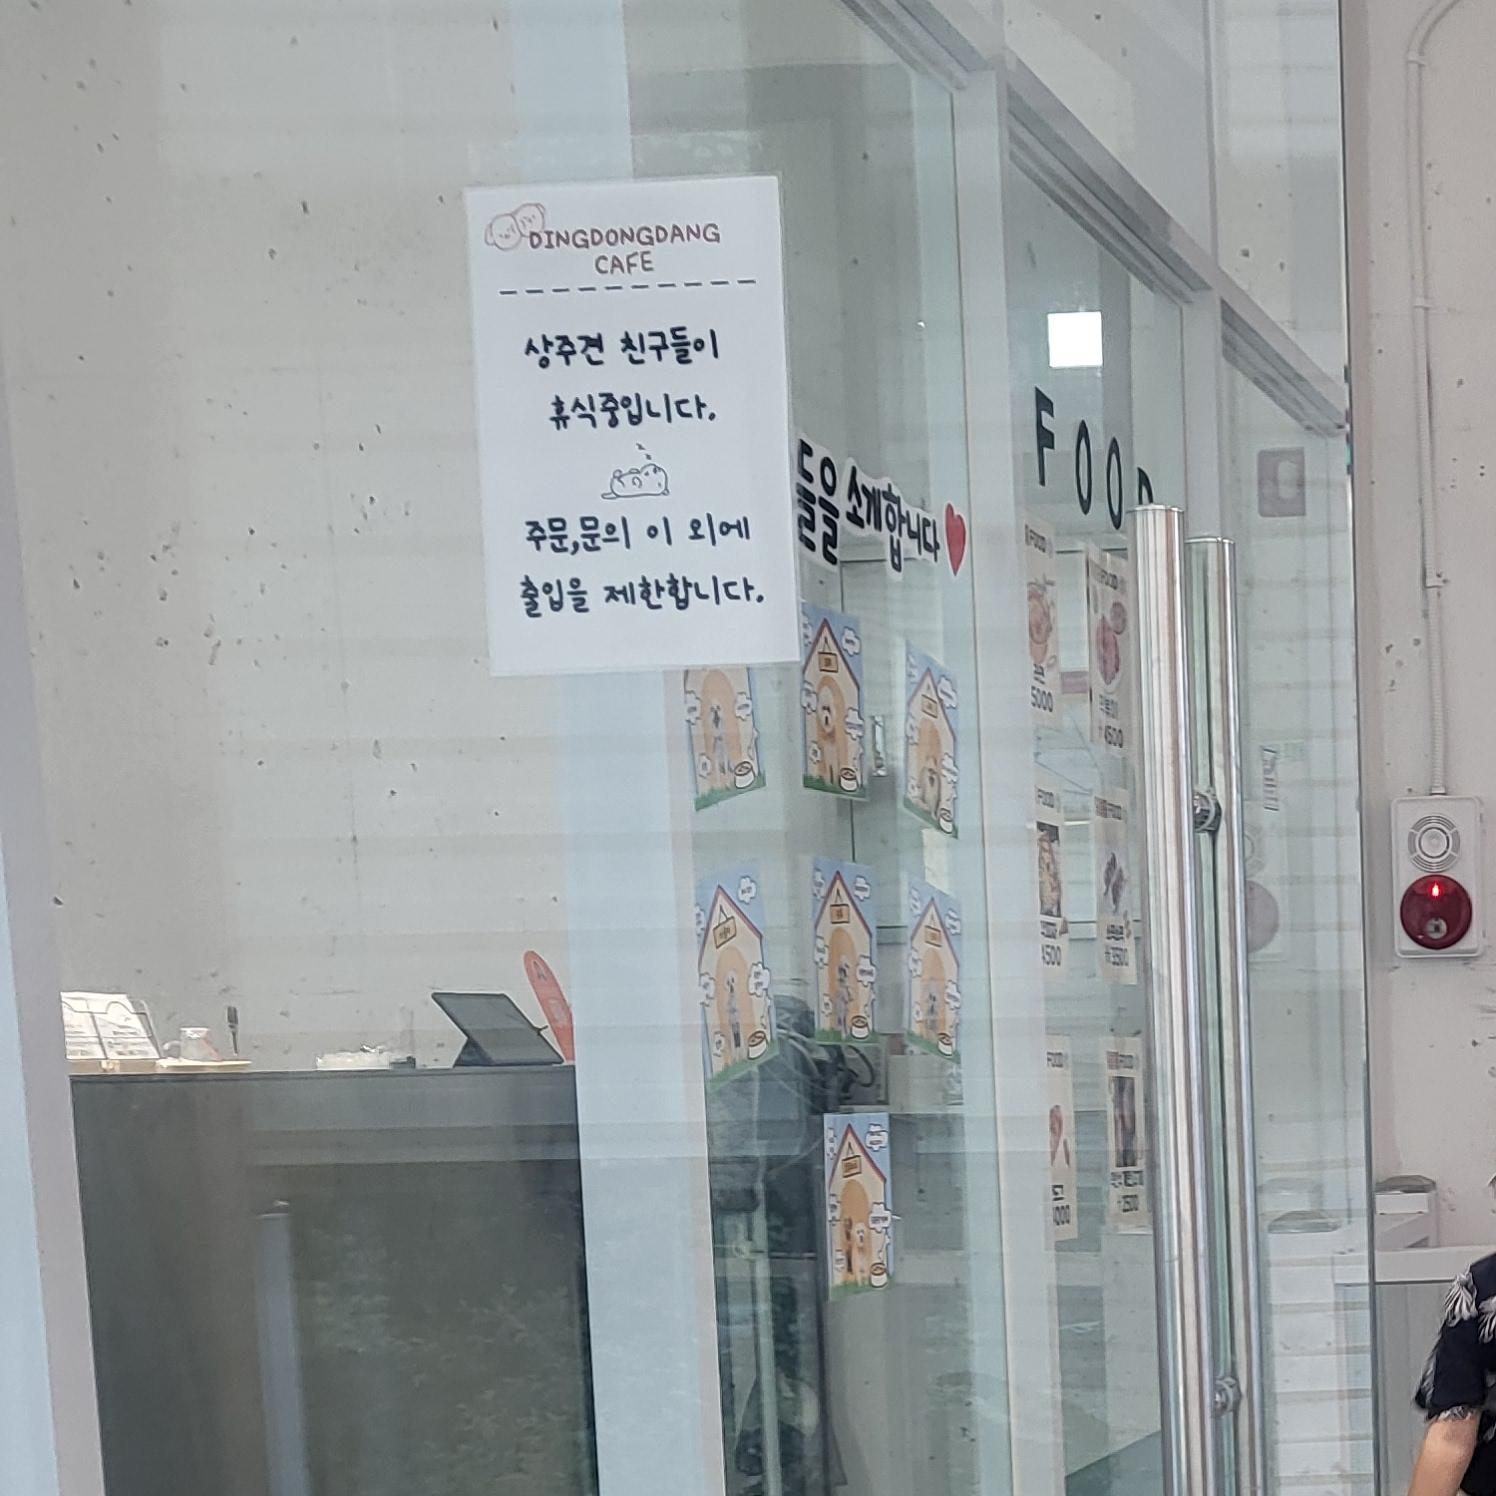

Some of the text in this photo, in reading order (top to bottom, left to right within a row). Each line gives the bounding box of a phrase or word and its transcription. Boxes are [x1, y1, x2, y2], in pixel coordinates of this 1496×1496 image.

[528, 222, 721, 250] DINGDONGDANG
[594, 251, 655, 276] CAFE
[523, 327, 720, 369] 상주견 친구들이
[549, 392, 717, 430] 휴식중입니다.
[646, 514, 673, 546] 이
[688, 512, 751, 547] 외에
[519, 572, 766, 618] 출입을 제한합니다.
